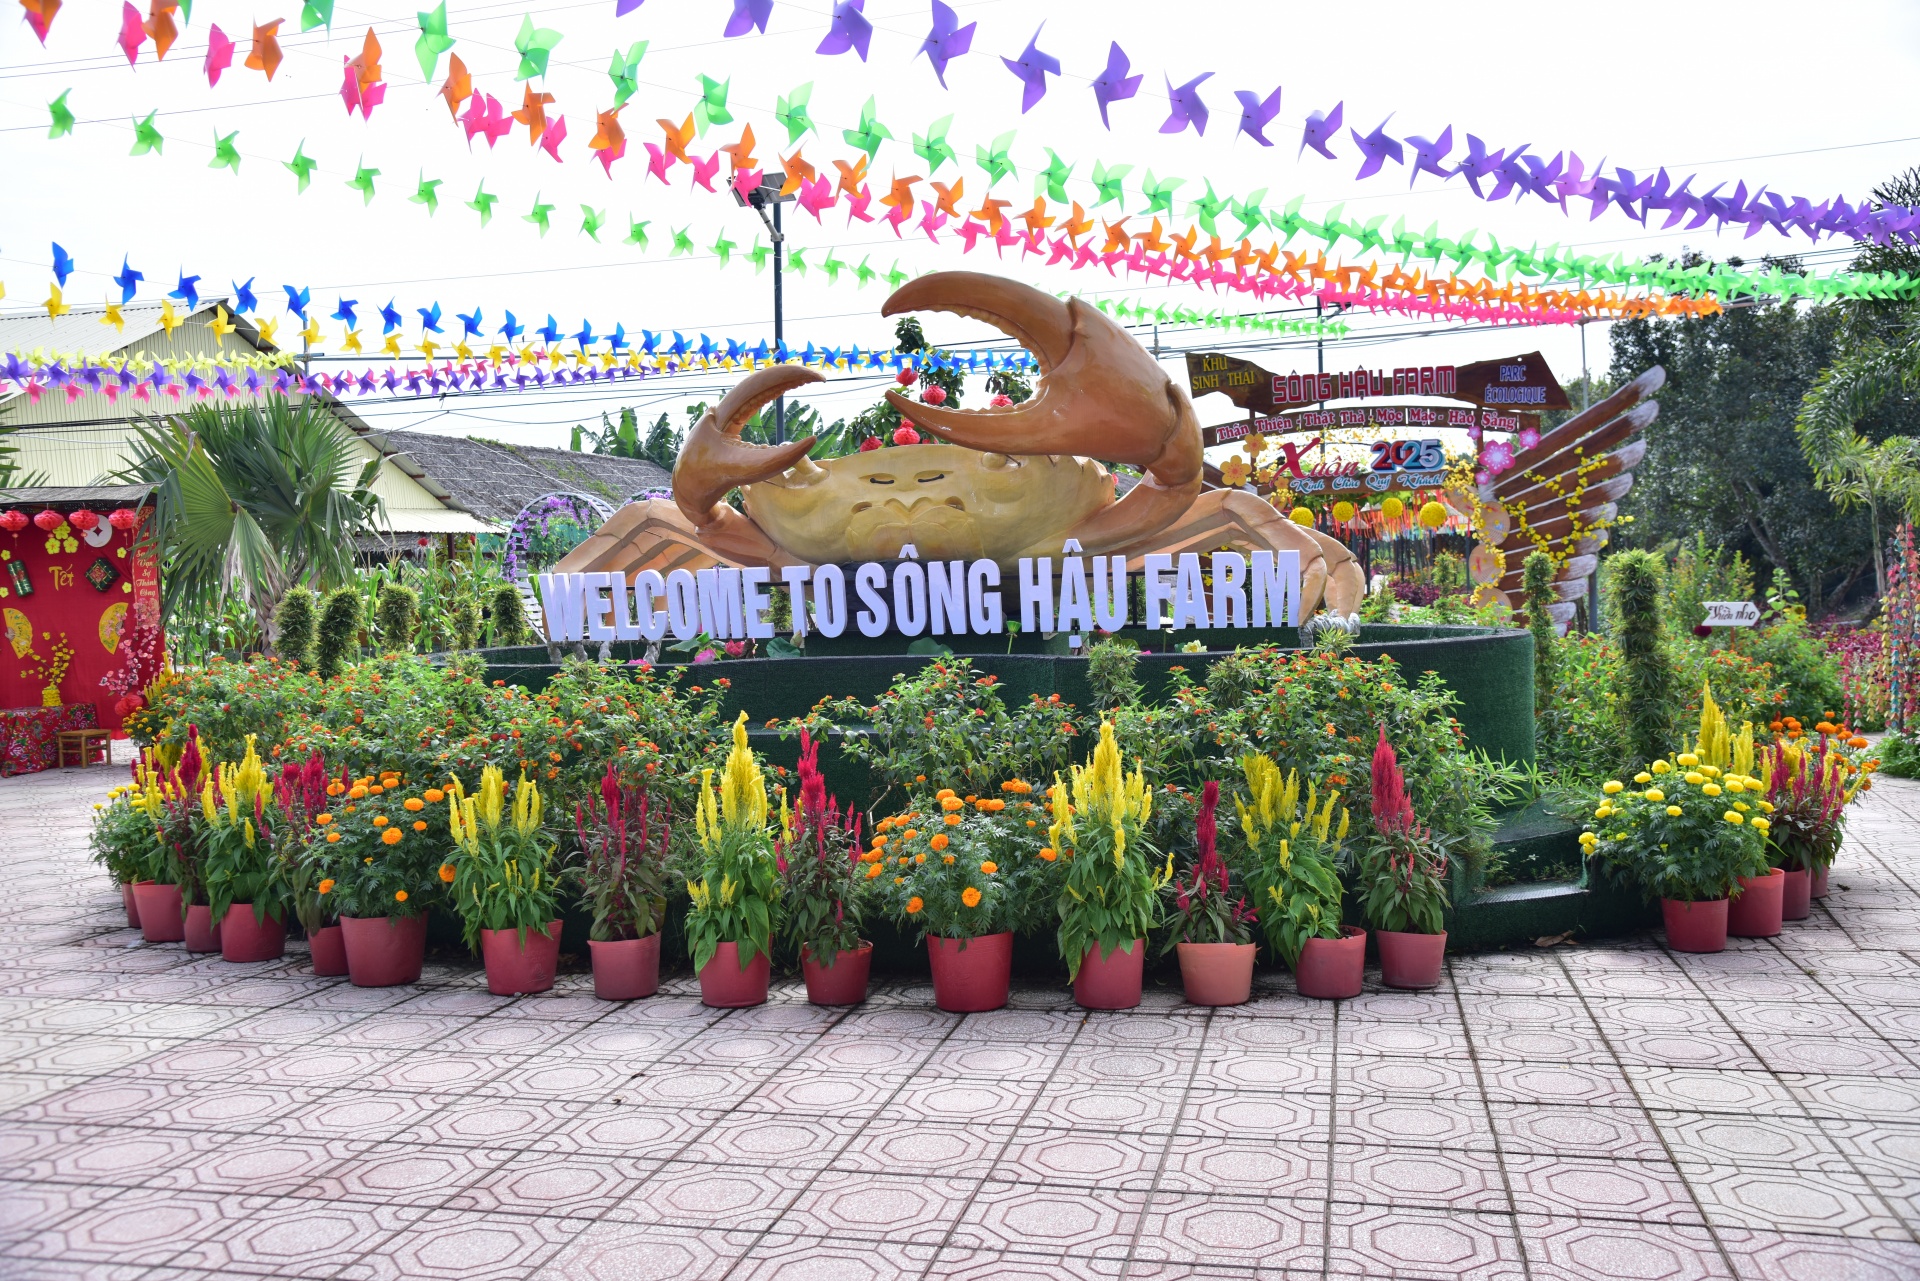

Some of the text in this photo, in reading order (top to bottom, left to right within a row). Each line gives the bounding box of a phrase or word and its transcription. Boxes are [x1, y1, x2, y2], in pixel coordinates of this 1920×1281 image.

[1203, 357, 1228, 372] KHU
[1500, 365, 1526, 382] PARC
[1192, 370, 1255, 390] SINH THÁI
[1272, 365, 1456, 404] SÔNG HẬU FARM
[1485, 384, 1546, 404] ÉCOLOGIQUE
[1254, 416, 1293, 433] Thiện
[1303, 411, 1336, 428] Thật
[1339, 410, 1365, 425] Thà
[1375, 408, 1403, 425] Mộc
[1409, 408, 1436, 426] Mạc
[1447, 409, 1475, 425] Hào
[1481, 411, 1516, 432] Sảng
[1269, 437, 1446, 488] Xuân 2025
[1290, 478, 1325, 494] Kính
[1365, 473, 1391, 491] Quý
[48, 564, 75, 591] Tết
[539, 538, 1301, 649] WELCOME TO SÔNG HẬU FARM
[1735, 603, 1756, 621] nho
